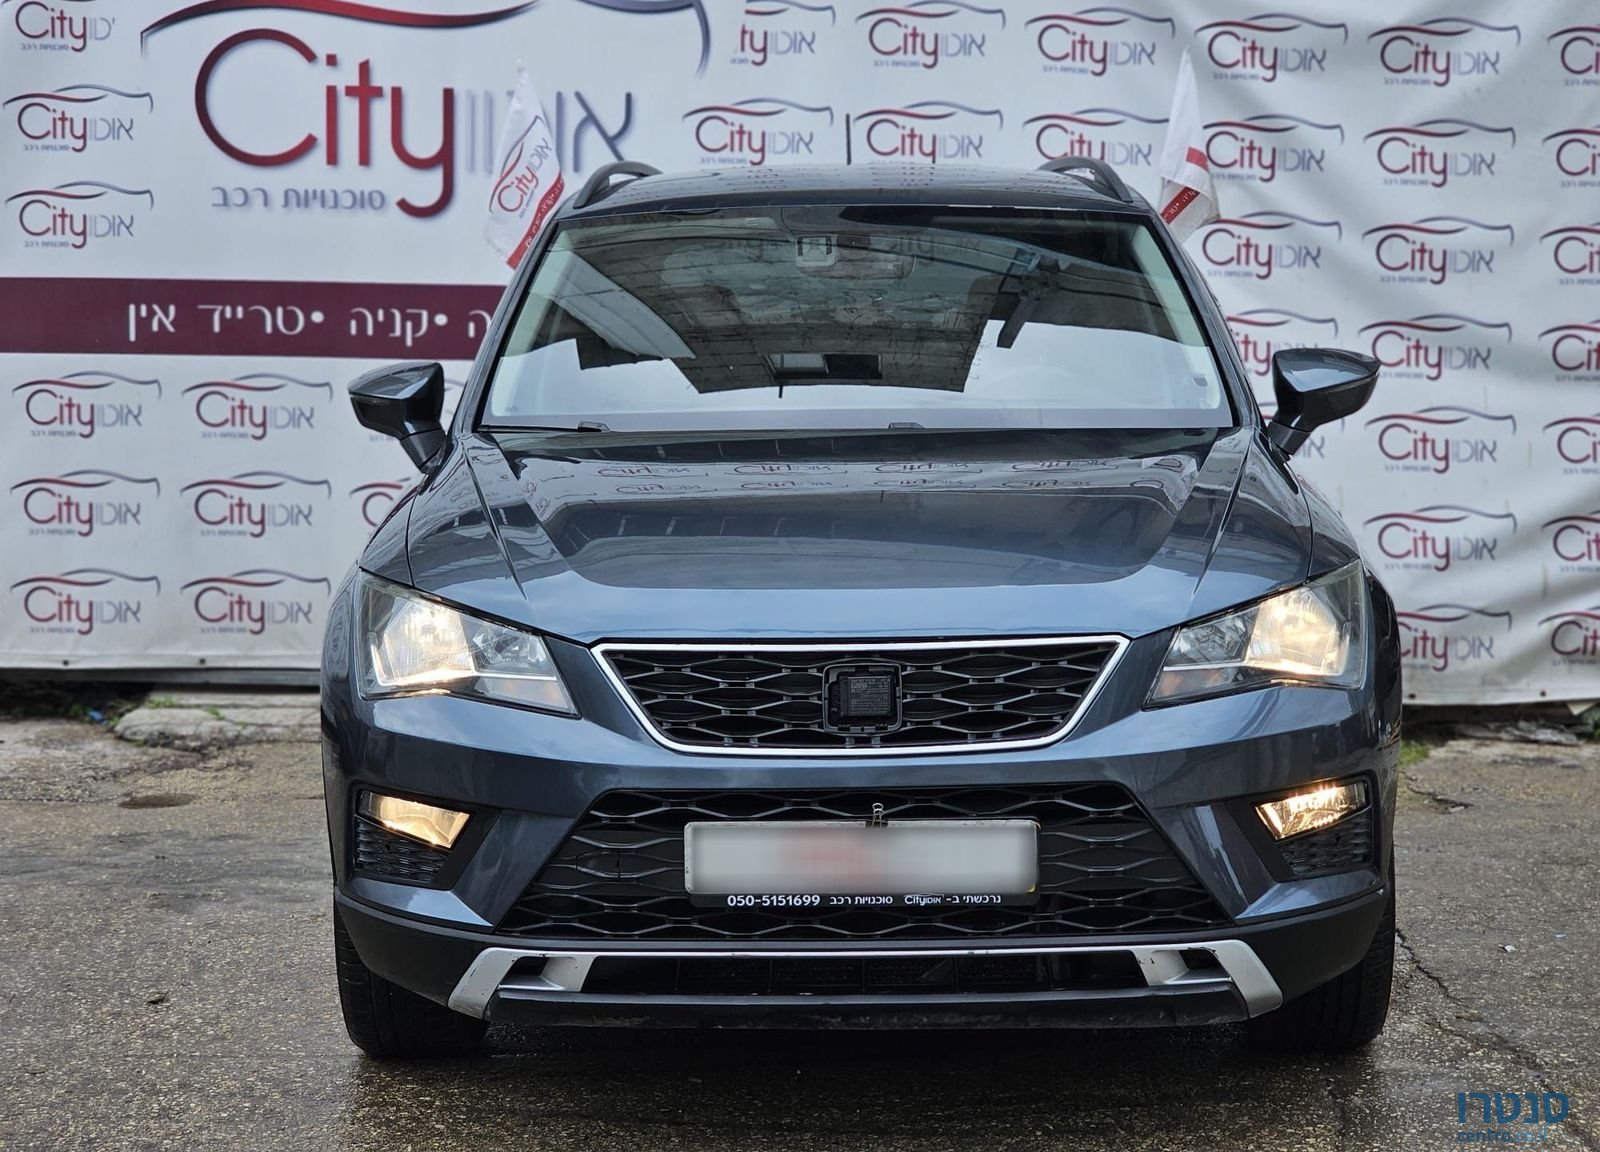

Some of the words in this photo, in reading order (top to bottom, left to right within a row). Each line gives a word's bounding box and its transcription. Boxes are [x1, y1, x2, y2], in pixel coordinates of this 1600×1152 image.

[15, 1, 87, 52] City
[869, 18, 938, 68] City
[1038, 24, 1107, 76] City
[1208, 30, 1278, 82] City
[1380, 35, 1450, 87] City
[1561, 36, 1600, 74] Ci
[18, 102, 87, 153] City
[194, 28, 455, 218] City
[695, 115, 766, 166] City
[867, 119, 937, 163] City
[1205, 131, 1276, 182] City
[1377, 137, 1447, 188] City
[1556, 138, 1600, 176] Ci
[211, 186, 270, 208] רכב
[282, 187, 386, 211] סוכנויות
[498, 165, 539, 212] City
[19, 199, 87, 249] City
[1202, 228, 1272, 280] City
[1376, 233, 1447, 285] City
[128, 303, 176, 342] אין
[1236, 333, 1271, 377] ity
[1372, 330, 1443, 381] City
[1552, 333, 1600, 371] Cit
[26, 389, 95, 438] City
[196, 391, 267, 440] City
[1379, 423, 1450, 474] City
[1557, 426, 1600, 464] Ci
[24, 487, 93, 536] City
[194, 489, 265, 537] City
[1378, 522, 1450, 571] City
[1553, 524, 1600, 561] Cit
[24, 586, 93, 635] City
[194, 587, 266, 635] City
[1551, 620, 1600, 655] Cit
[727, 894, 821, 906] 050-5151699
[830, 896, 851, 905] רכב
[854, 896, 893, 905] סוכנויות
[904, 895, 926, 907] City
[962, 895, 1002, 904] נרכשתי
